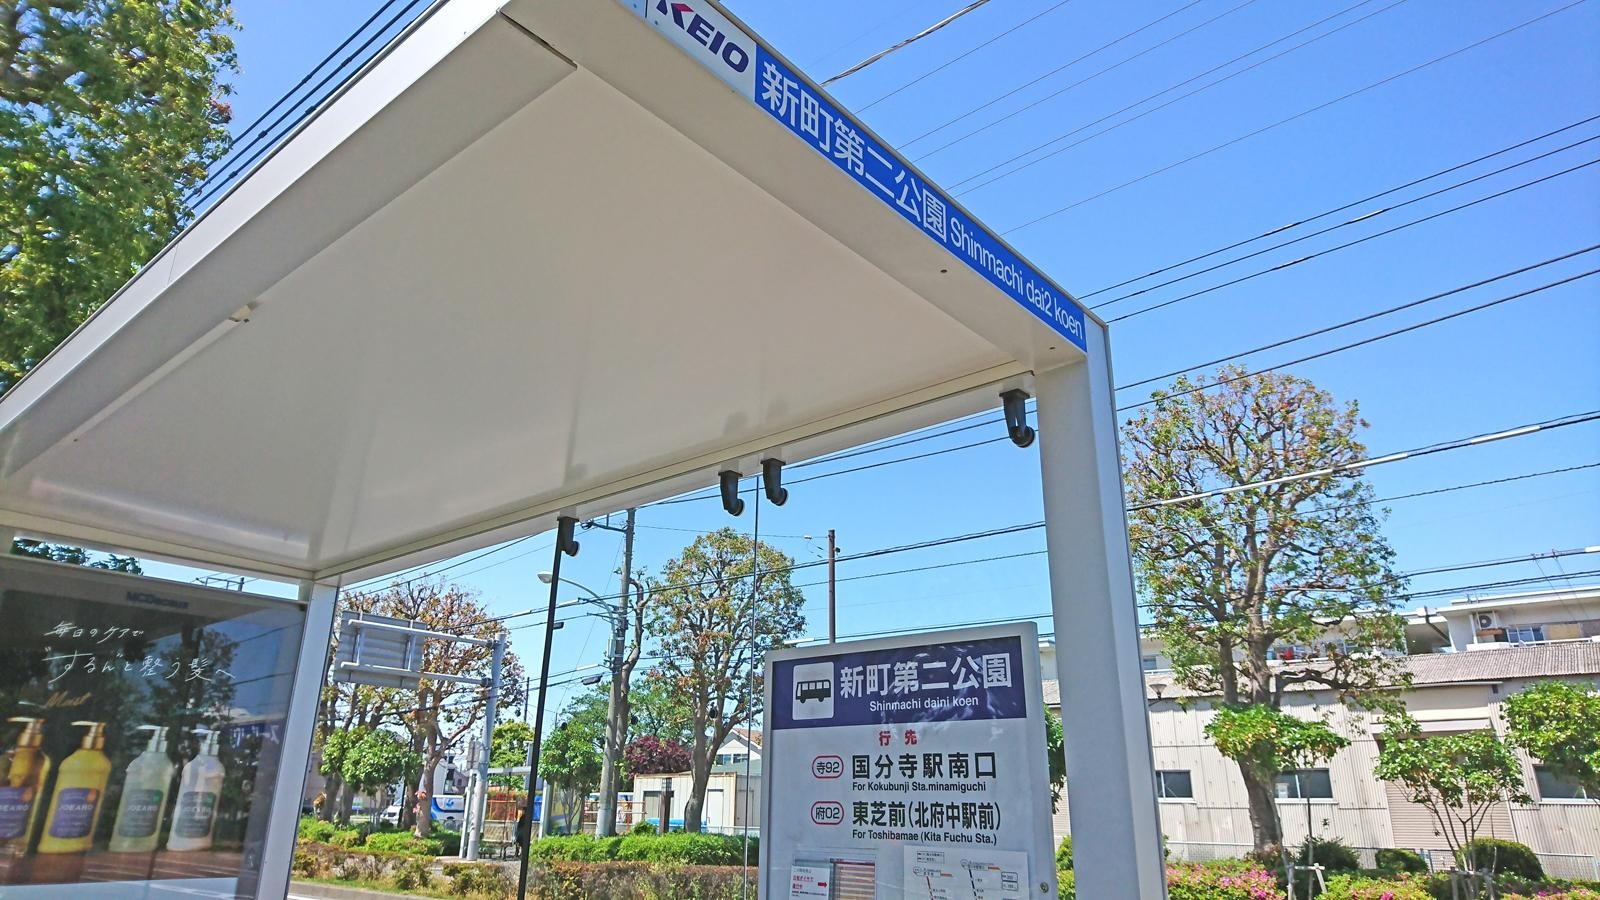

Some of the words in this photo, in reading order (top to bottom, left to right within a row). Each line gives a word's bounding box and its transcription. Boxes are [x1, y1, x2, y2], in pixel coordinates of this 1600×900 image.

[656, 0, 749, 73] KEIO
[762, 61, 947, 243] 新町第二公園
[951, 217, 1023, 296] Shinmachi
[1026, 280, 1053, 317] dai2
[1054, 298, 1083, 340] koen
[44, 620, 144, 644] 毎日のケアで
[840, 653, 1012, 698] 新町第二公園
[870, 698, 921, 712] Shinmachi
[924, 697, 949, 709] daini
[953, 696, 979, 707] koen
[816, 761, 840, 775] 寺92
[852, 752, 997, 779] 国分寺駅南口
[852, 782, 865, 791] For
[868, 782, 909, 793] Kokubunji
[815, 806, 840, 820] 府02
[852, 801, 1001, 830] 東芝前(北府中駅前)
[852, 830, 865, 839] For
[868, 830, 919, 841] Toshibamae
[921, 831, 942, 842] (Kita
[944, 832, 973, 843] Fuchu
[975, 833, 997, 845] Sta.)
